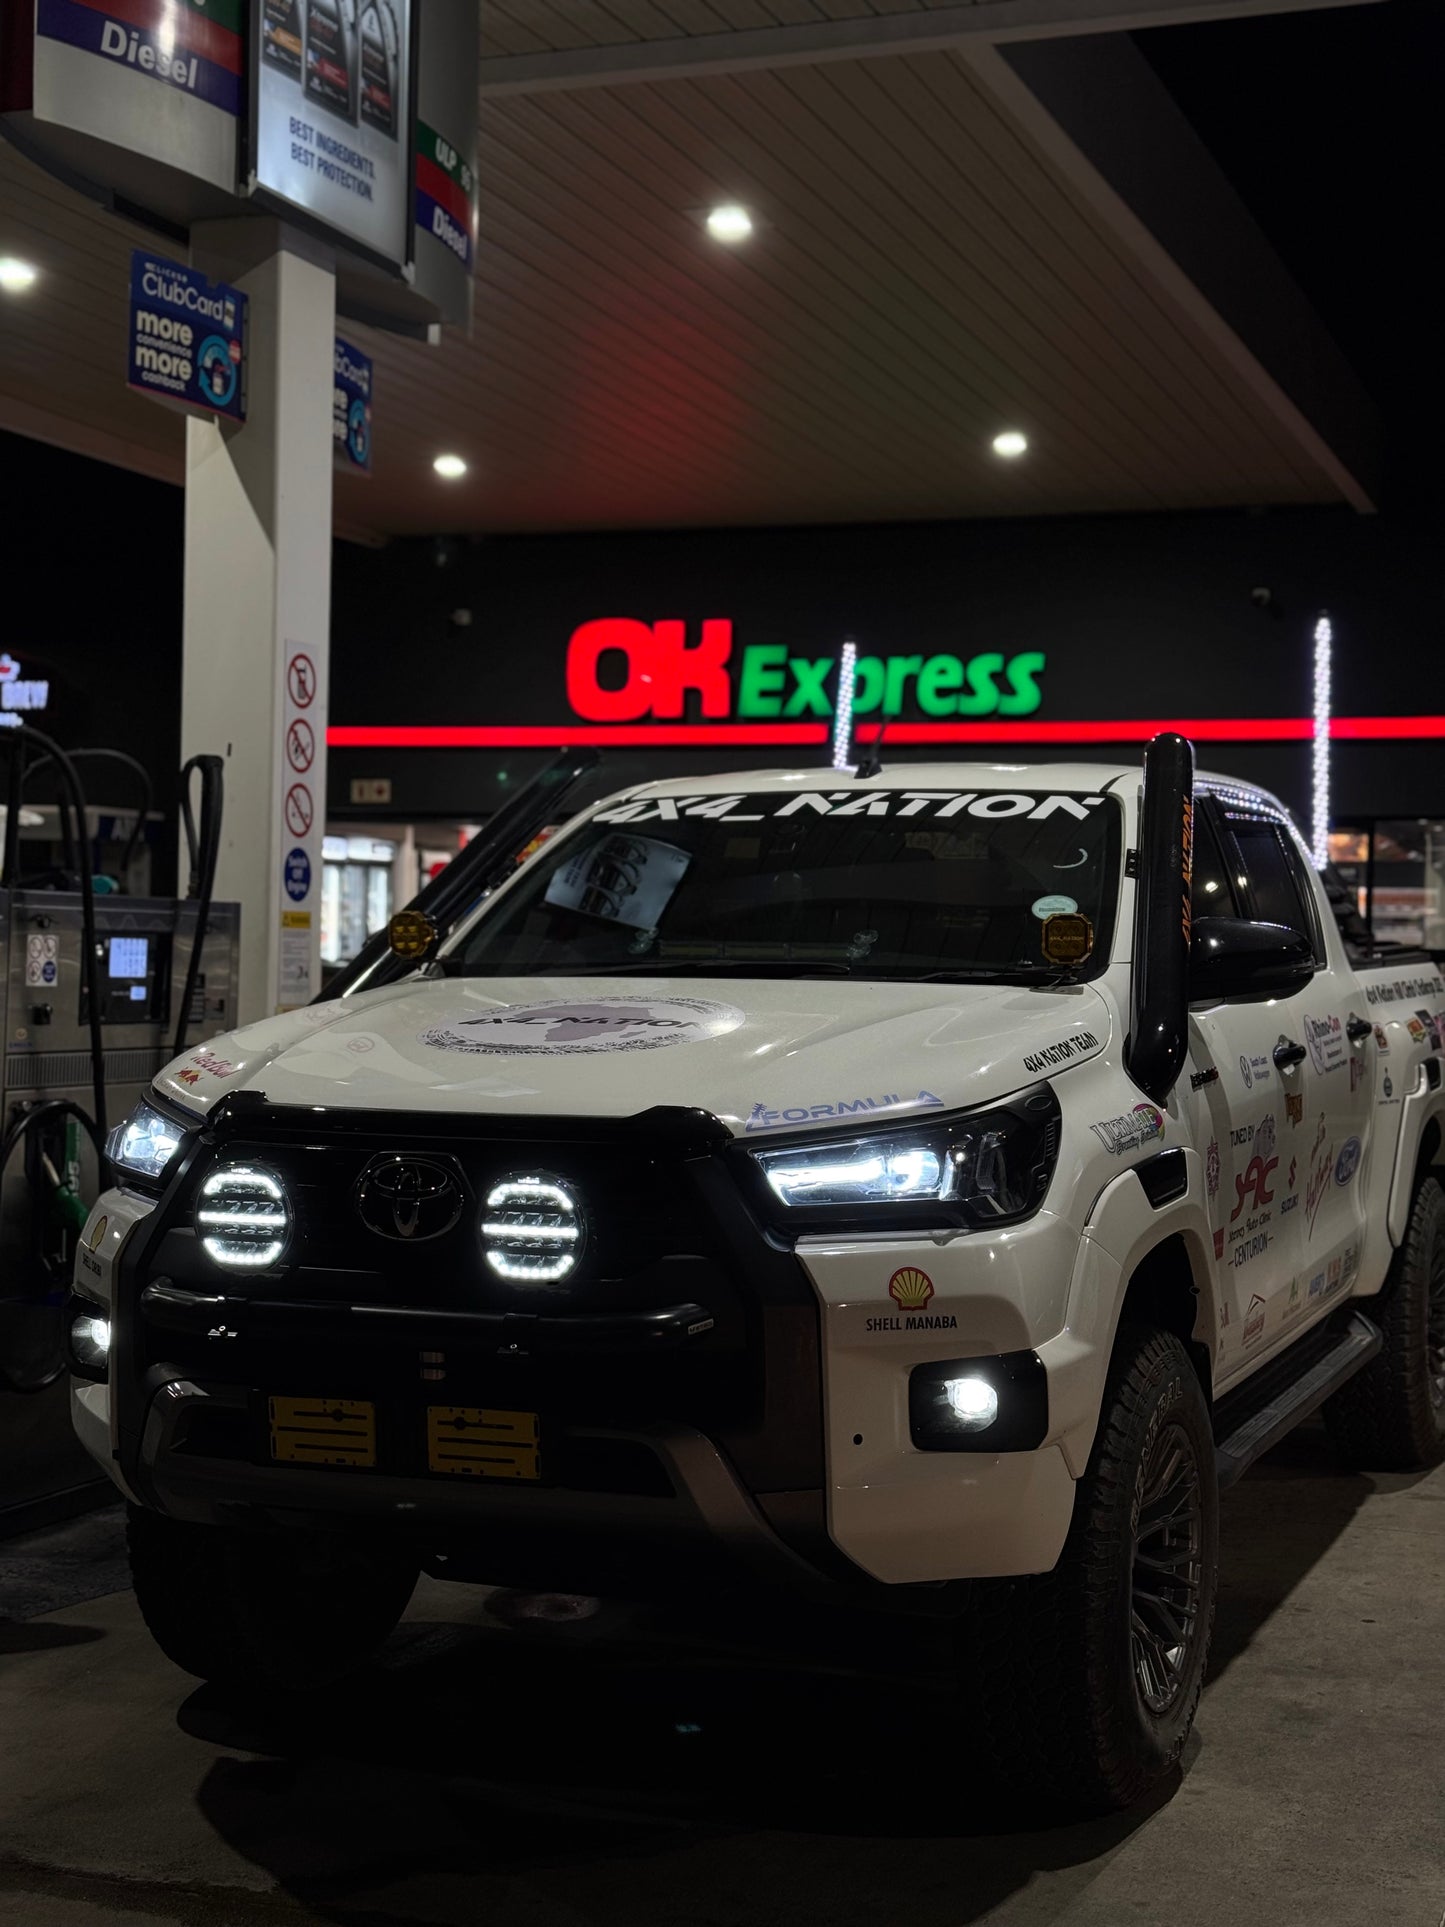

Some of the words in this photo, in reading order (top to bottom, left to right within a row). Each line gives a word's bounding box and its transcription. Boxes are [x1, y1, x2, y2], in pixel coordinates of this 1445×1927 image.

[101, 20, 198, 88] Diesel
[289, 116, 313, 142] BEST
[291, 142, 314, 169] BEST
[435, 137, 457, 170] ULP
[432, 207, 467, 260] Diesel
[142, 272, 223, 320] ClubCard
[136, 310, 193, 346] more
[136, 346, 193, 381] more
[566, 617, 733, 721] OK
[738, 644, 1046, 735] Express
[773, 792, 1105, 821] NATION
[1023, 1051, 1045, 1074] 4X4
[1041, 1037, 1073, 1065] NATION
[1071, 1031, 1099, 1052] TEAM
[1090, 1108, 1157, 1154] ULTIMATE
[1230, 1127, 1248, 1149] TUNED
[1233, 1231, 1268, 1268] CENTURION
[866, 1317, 902, 1331] SHELL
[905, 1316, 958, 1330] MANABA
